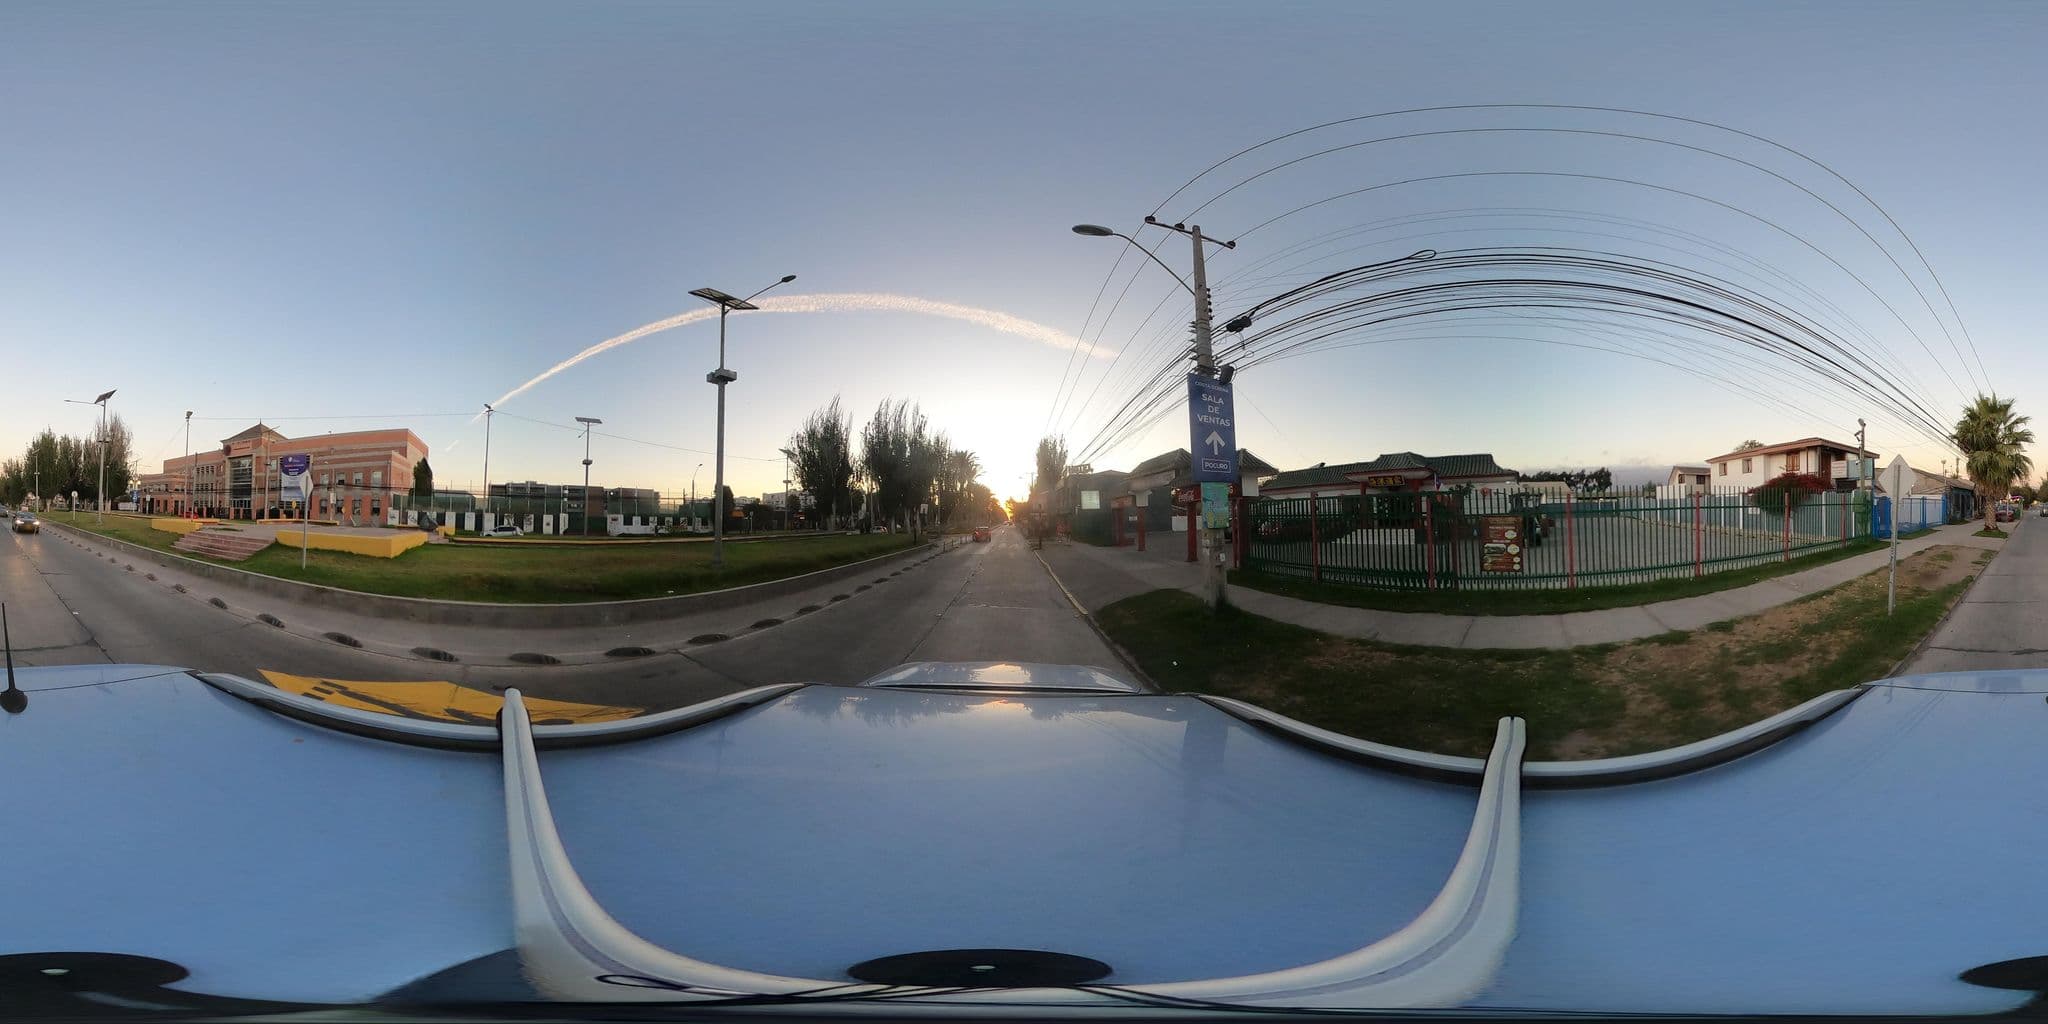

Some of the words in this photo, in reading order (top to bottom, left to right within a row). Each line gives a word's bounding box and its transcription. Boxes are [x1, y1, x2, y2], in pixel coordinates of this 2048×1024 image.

[1201, 393, 1224, 405] SALA
[1207, 405, 1220, 414] DE
[1196, 414, 1231, 427] VENTAS
[1204, 461, 1228, 470] POCURO
